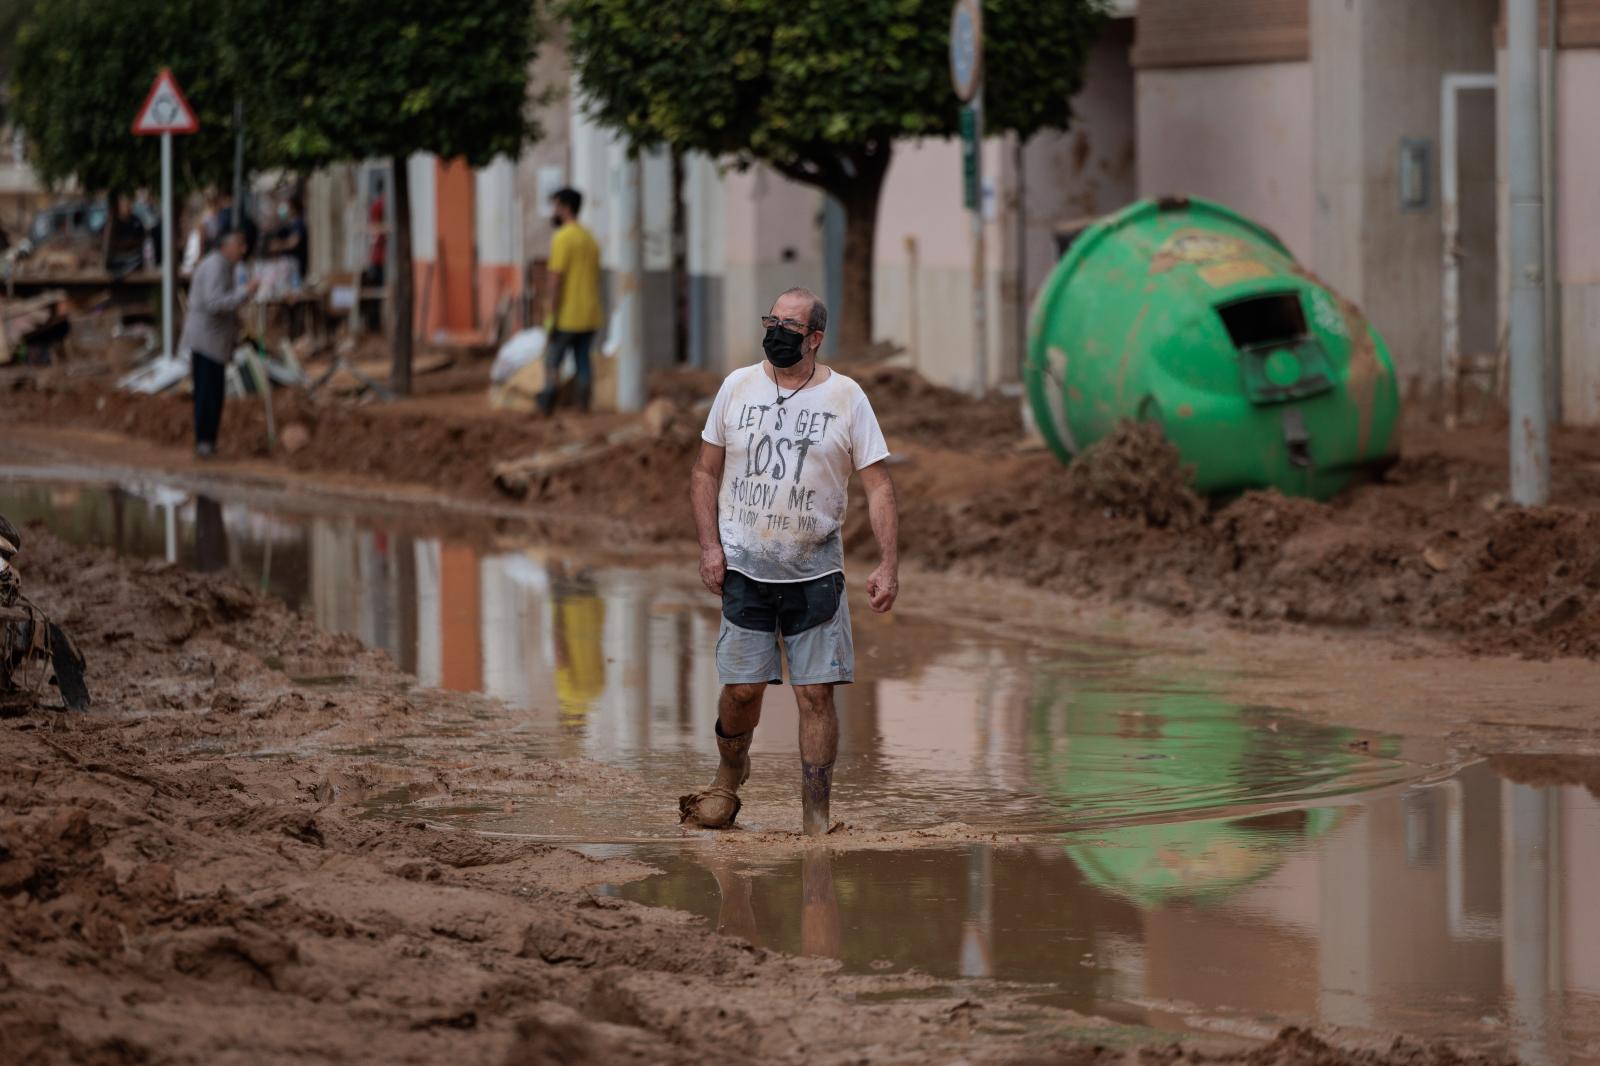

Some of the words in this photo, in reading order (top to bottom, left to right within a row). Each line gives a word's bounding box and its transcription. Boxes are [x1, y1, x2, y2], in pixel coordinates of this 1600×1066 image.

[796, 409, 837, 440] GET
[745, 433, 819, 484] LOST
[731, 477, 778, 510] FOLLOW
[788, 485, 816, 511] ME
[727, 504, 735, 521] I
[761, 513, 791, 530] THE
[798, 515, 817, 534] WAY
